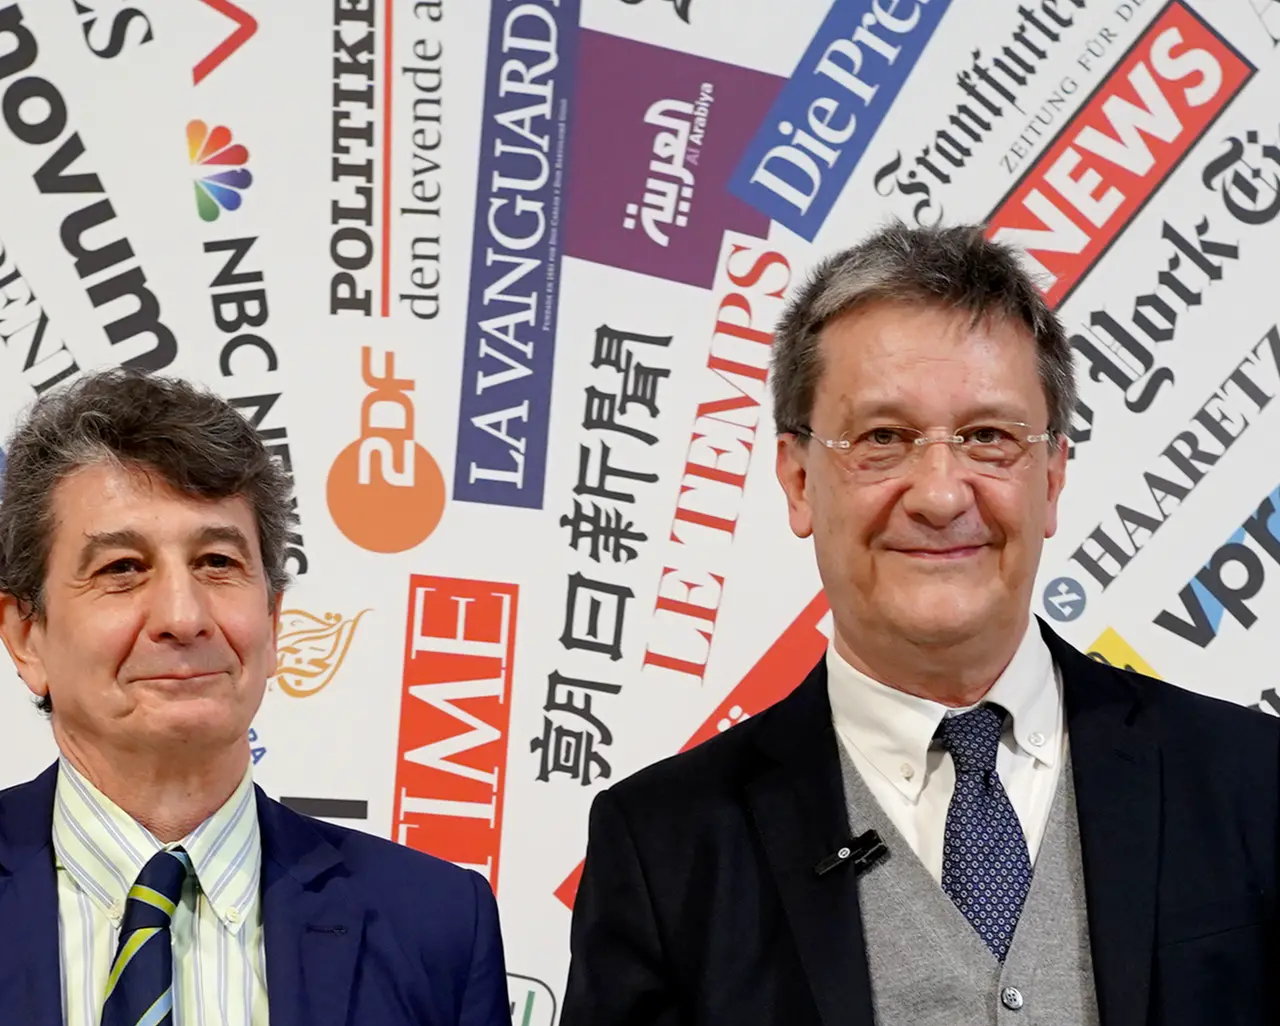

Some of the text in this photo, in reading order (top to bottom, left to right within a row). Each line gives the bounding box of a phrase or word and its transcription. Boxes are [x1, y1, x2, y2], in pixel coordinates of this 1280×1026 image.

[400, 38, 444, 218] levende
[623, 97, 695, 246] العربية
[690, 83, 714, 146] Arabiya
[750, 94, 857, 217] Die
[873, 0, 1086, 228] Frankfurte
[993, 26, 1223, 294] NEWS
[999, 76, 1079, 174] ZEITUNG
[1076, 26, 1118, 72] FÜR
[203, 236, 278, 377] NBC
[399, 236, 440, 320] den
[468, 0, 561, 490] LA VANGUARD
[1068, 215, 1240, 414] York
[358, 345, 416, 488] ZDF
[642, 241, 792, 686] LE TEMPS
[530, 323, 674, 787] 朝日新聞
